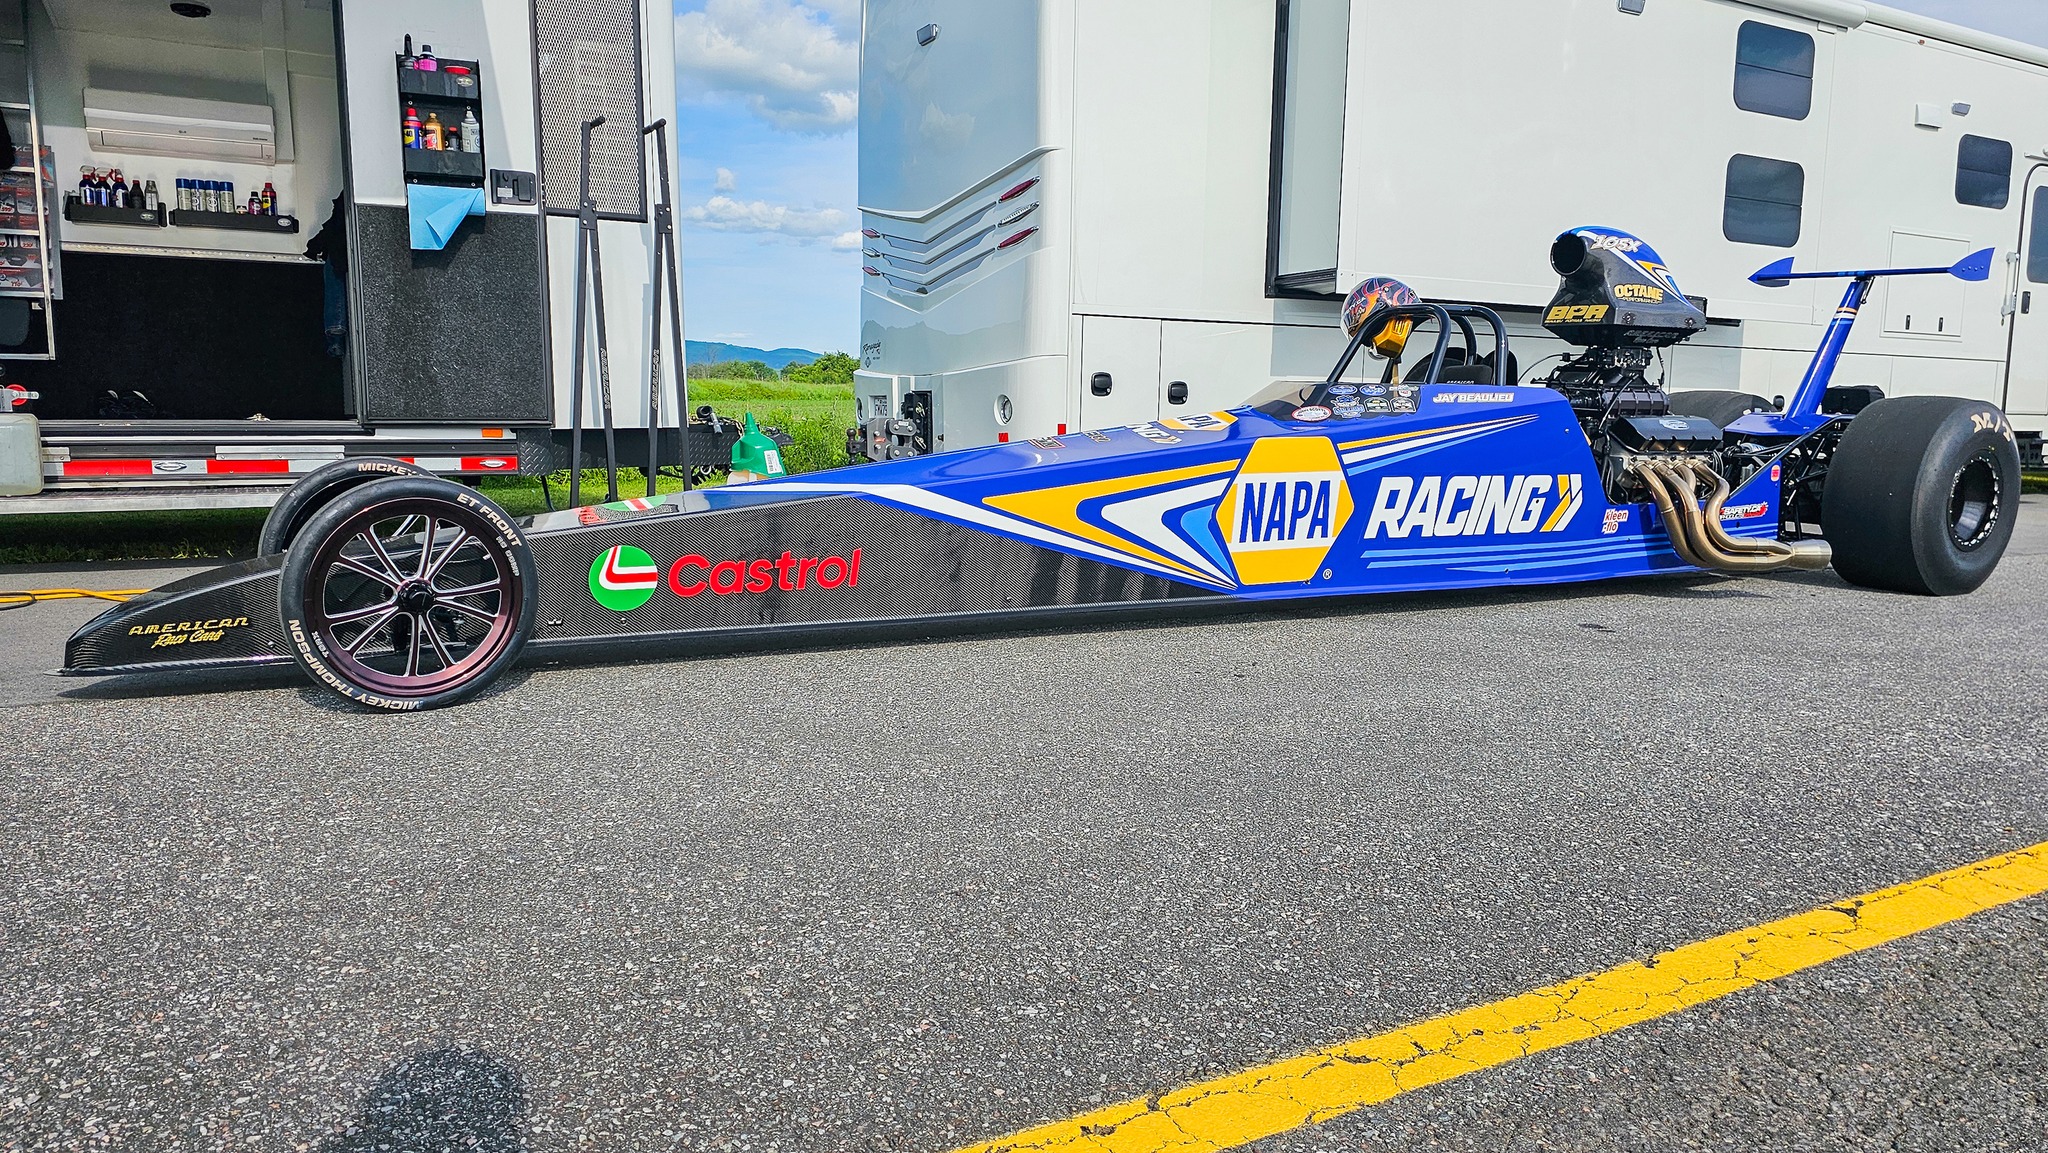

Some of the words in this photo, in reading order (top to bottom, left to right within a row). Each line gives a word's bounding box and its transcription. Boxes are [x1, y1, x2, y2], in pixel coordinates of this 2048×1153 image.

[1614, 284, 1664, 301] OCTANE
[1432, 392, 1457, 404] JAY
[1457, 392, 1515, 403] BEAULIEU
[1239, 480, 1331, 543] NAPA
[1364, 474, 1552, 539] RACING
[1605, 509, 1627, 521] kleen
[456, 493, 480, 508] ET
[479, 505, 523, 547] FRONT
[668, 548, 862, 598] Castrol
[128, 617, 249, 635] AMERICAN
[151, 633, 188, 649] Race
[189, 629, 225, 643] Cars
[288, 619, 353, 698] THOMPSON
[355, 693, 423, 711] MICKEY
